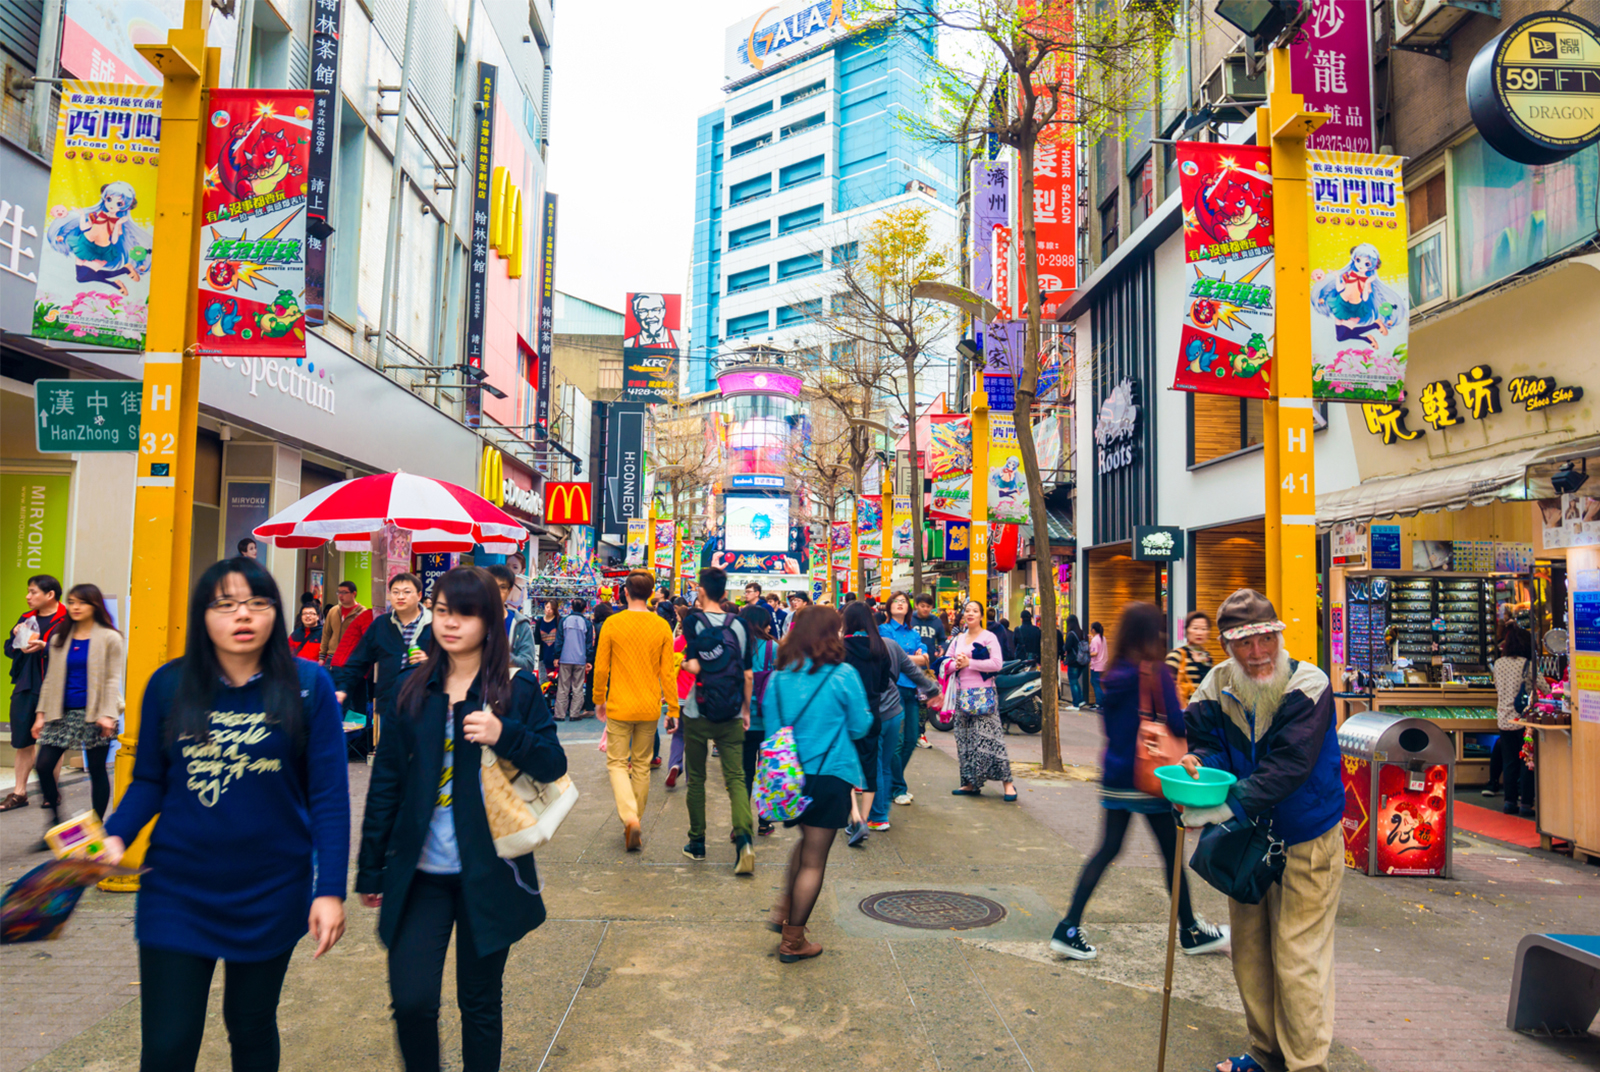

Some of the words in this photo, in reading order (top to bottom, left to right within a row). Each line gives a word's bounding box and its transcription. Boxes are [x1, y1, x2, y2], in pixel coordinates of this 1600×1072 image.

[747, 0, 875, 70] GALAX
[1559, 38, 1579, 46] NEW
[1311, 0, 1348, 94] 沙龍
[1560, 46, 1580, 54] ERA
[1529, 105, 1594, 120] DRAGON
[68, 109, 162, 142] 西門町
[66, 138, 107, 149] Welcome
[114, 143, 125, 151] to
[1061, 150, 1071, 178] HAIR
[1313, 178, 1396, 207] 西門町
[1061, 184, 1071, 224] SALON
[1314, 204, 1351, 214] Welcome
[1369, 208, 1396, 217] Ximen
[472, 210, 487, 274] 翰林茶館
[1019, 252, 1075, 267] 20-2988
[1038, 278, 1058, 290] 2F
[641, 359, 667, 367] KFC
[240, 356, 336, 416] spectrum
[1509, 377, 1547, 403] Xiao
[151, 385, 172, 411] H
[1526, 397, 1549, 411] Shoes
[1552, 389, 1573, 403] Shop
[51, 425, 119, 444] HanZhong
[128, 425, 140, 440] S
[141, 432, 175, 455] 32
[1288, 428, 1306, 453] H
[1098, 444, 1132, 476] Roots
[622, 451, 636, 519] H:CONNECT
[1281, 472, 1308, 494] 41
[231, 497, 266, 505] MIRYOKU
[27, 486, 46, 569] MIRYOKU
[975, 533, 985, 545] H
[973, 552, 987, 562] 39
[1143, 547, 1171, 556] Roots
[913, 625, 936, 638] GAP
